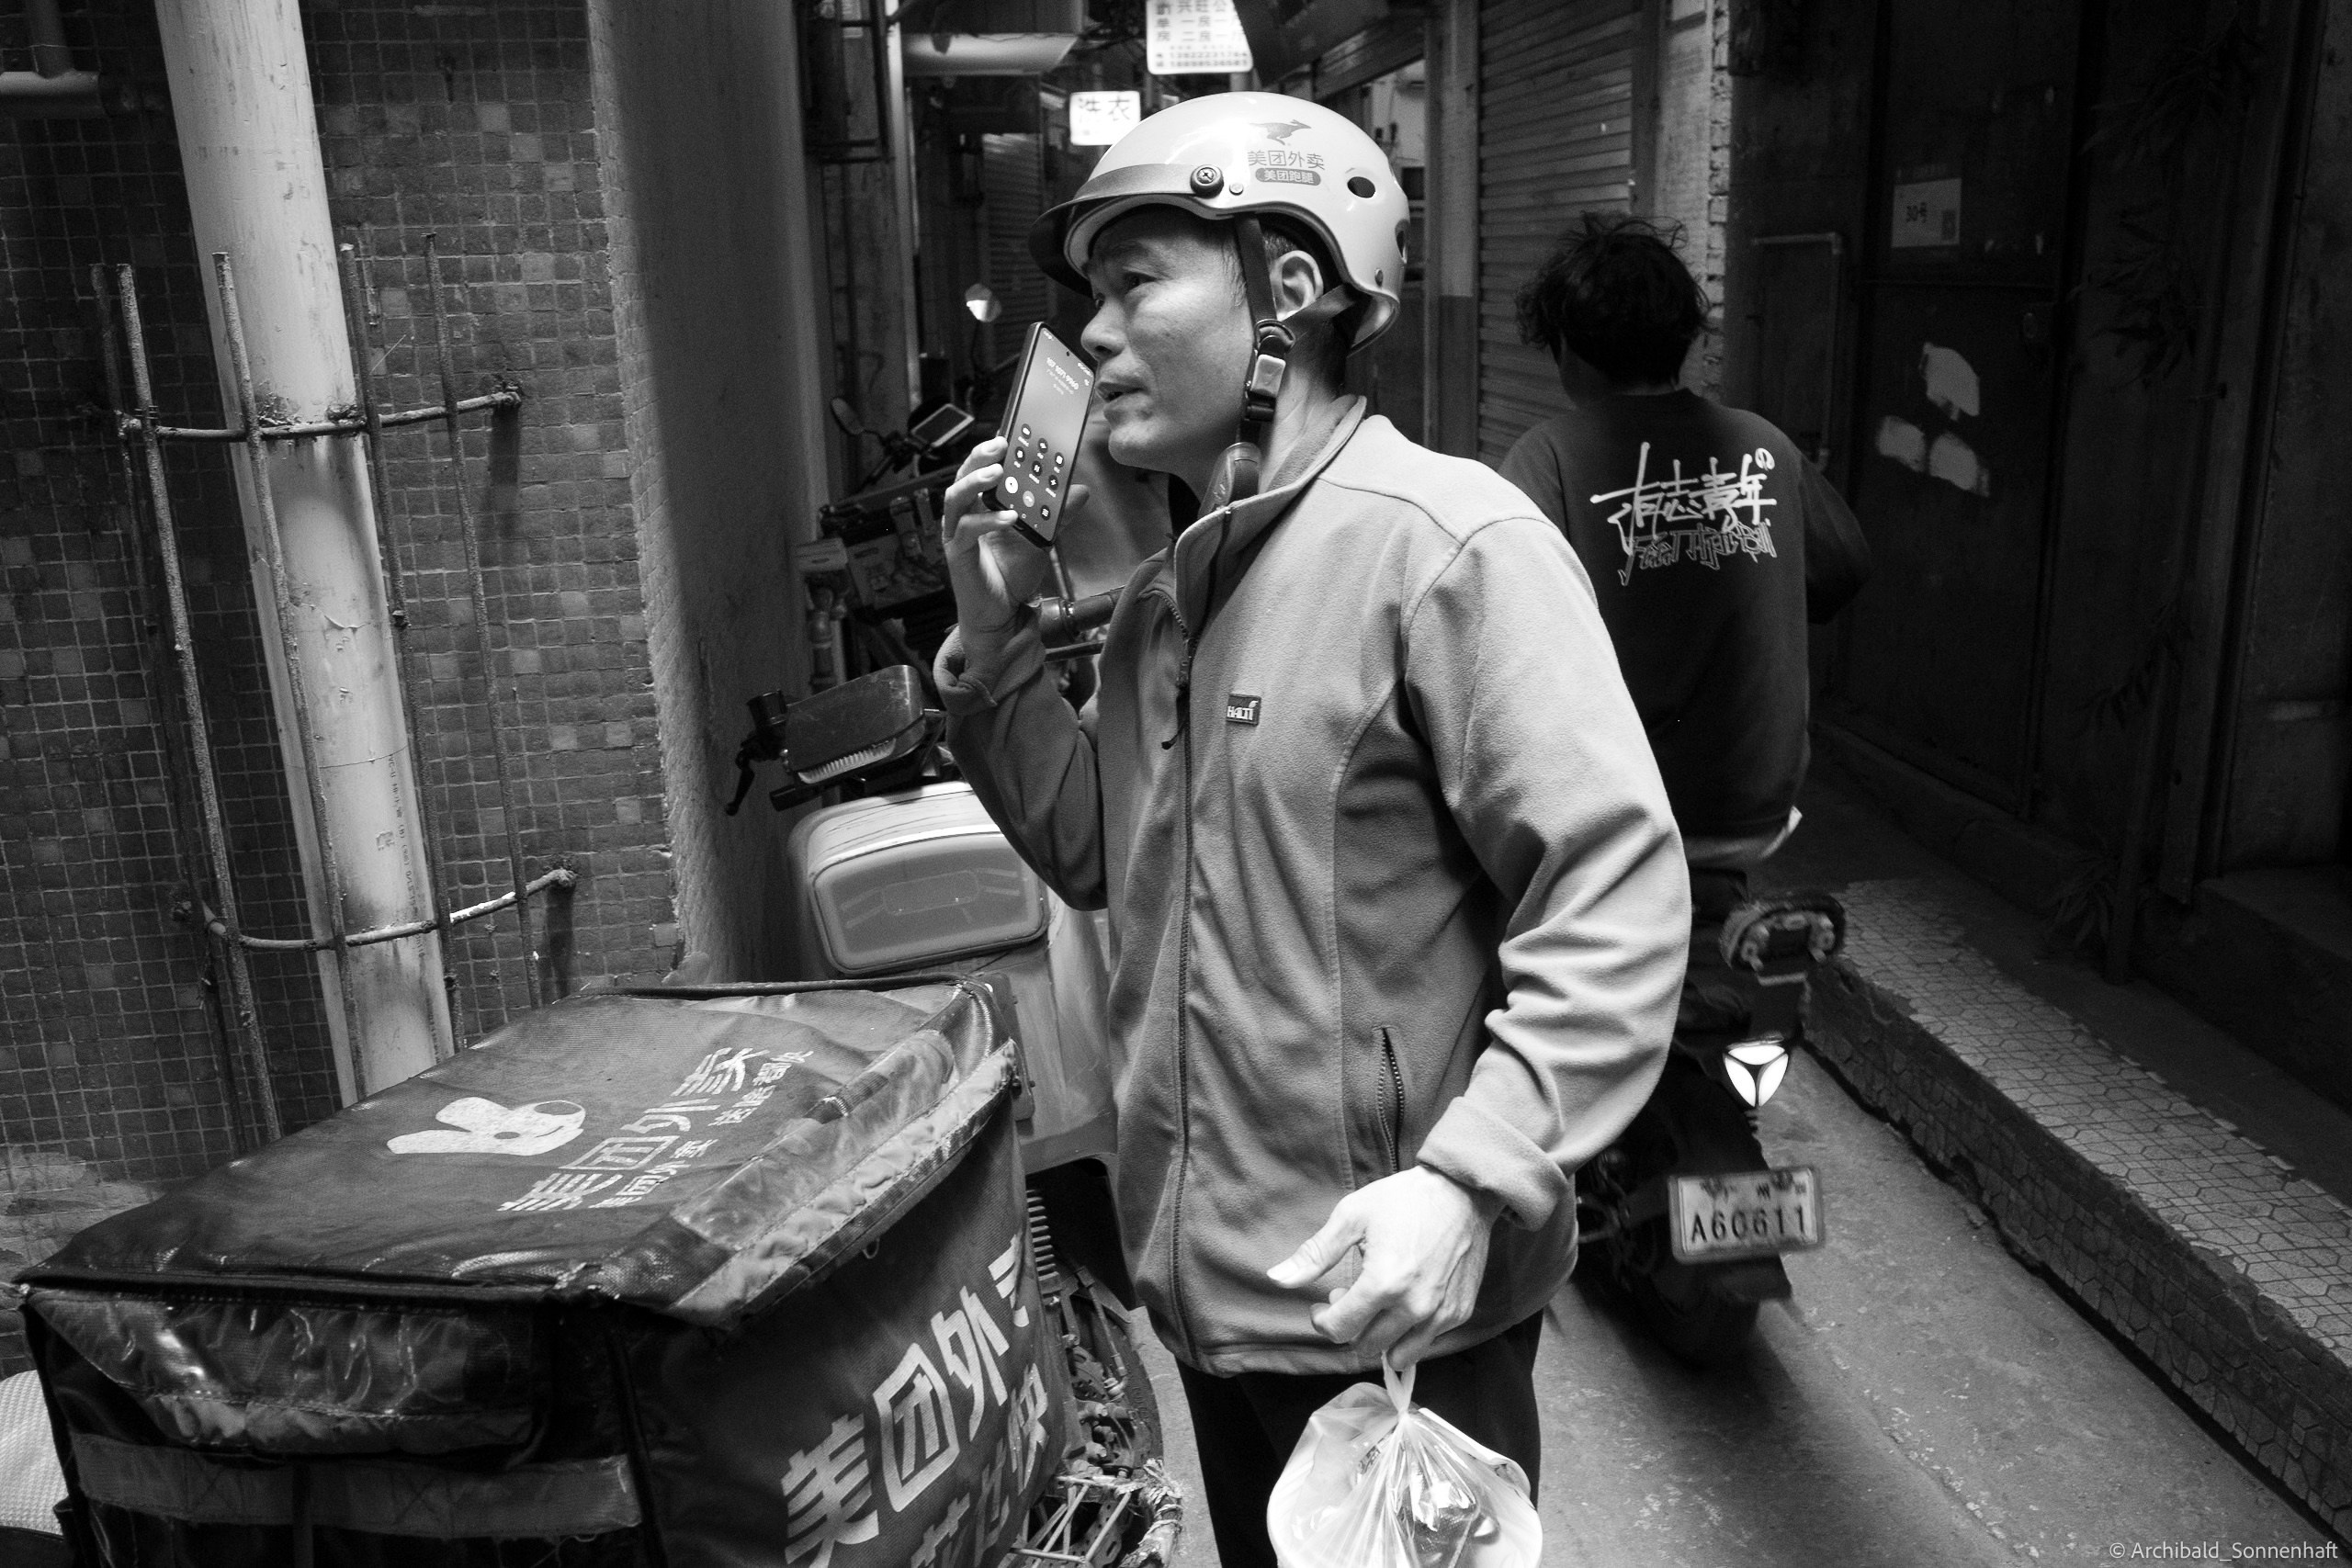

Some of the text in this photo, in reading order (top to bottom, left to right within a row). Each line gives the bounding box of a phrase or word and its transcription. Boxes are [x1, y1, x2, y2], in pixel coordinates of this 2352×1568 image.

[1247, 150, 1325, 171] 美团外卖
[1263, 169, 1315, 184] 美团跑腿
[496, 1047, 770, 1212] 美团外卖
[1690, 1204, 1805, 1244] A60611
